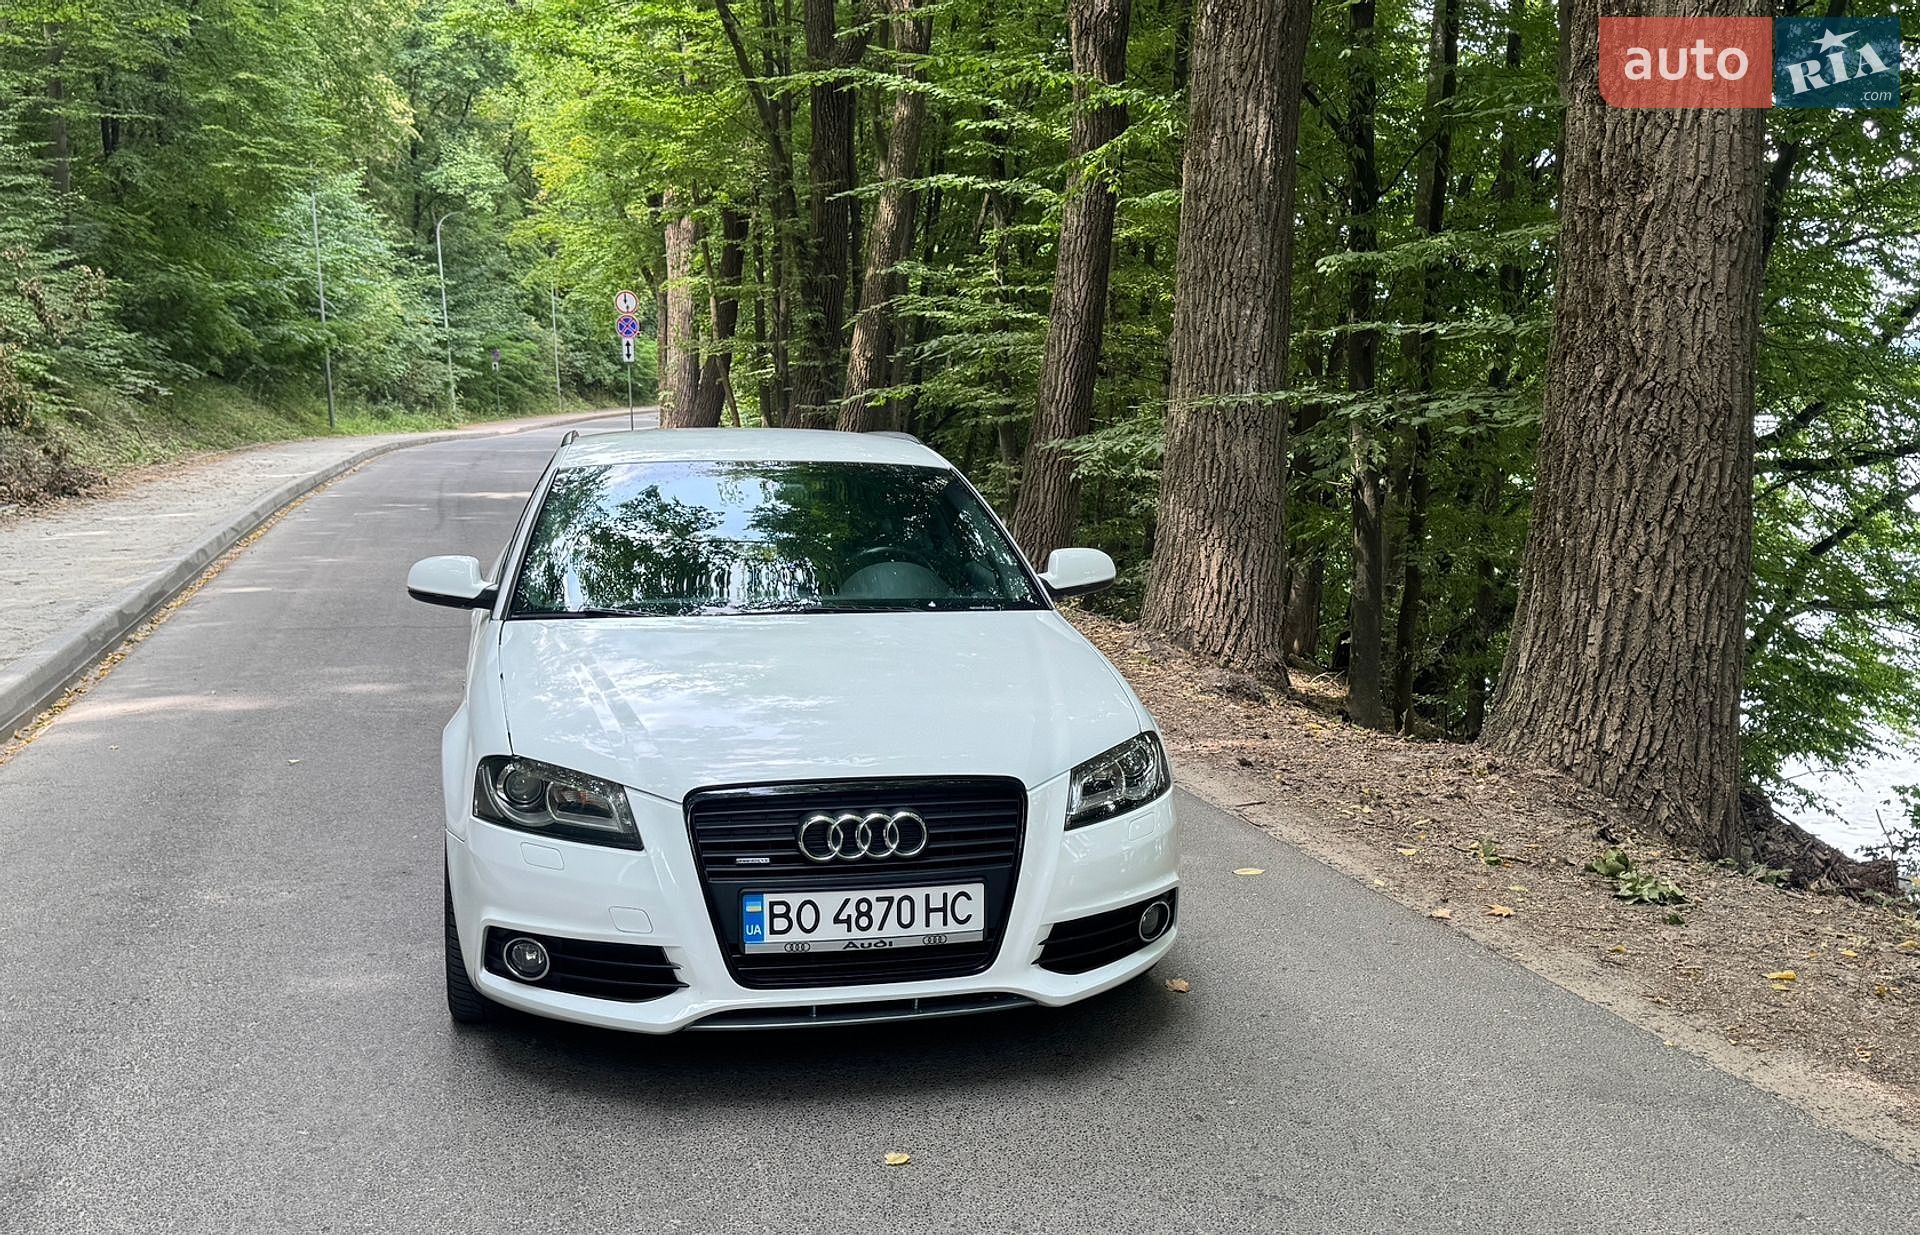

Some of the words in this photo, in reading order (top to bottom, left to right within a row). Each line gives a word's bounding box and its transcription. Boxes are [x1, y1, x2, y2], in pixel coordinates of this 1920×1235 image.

[768, 899, 821, 936] BO
[832, 894, 915, 933] 4870
[924, 890, 973, 928] HC
[745, 924, 762, 936] UA
[842, 939, 893, 950] Audi
